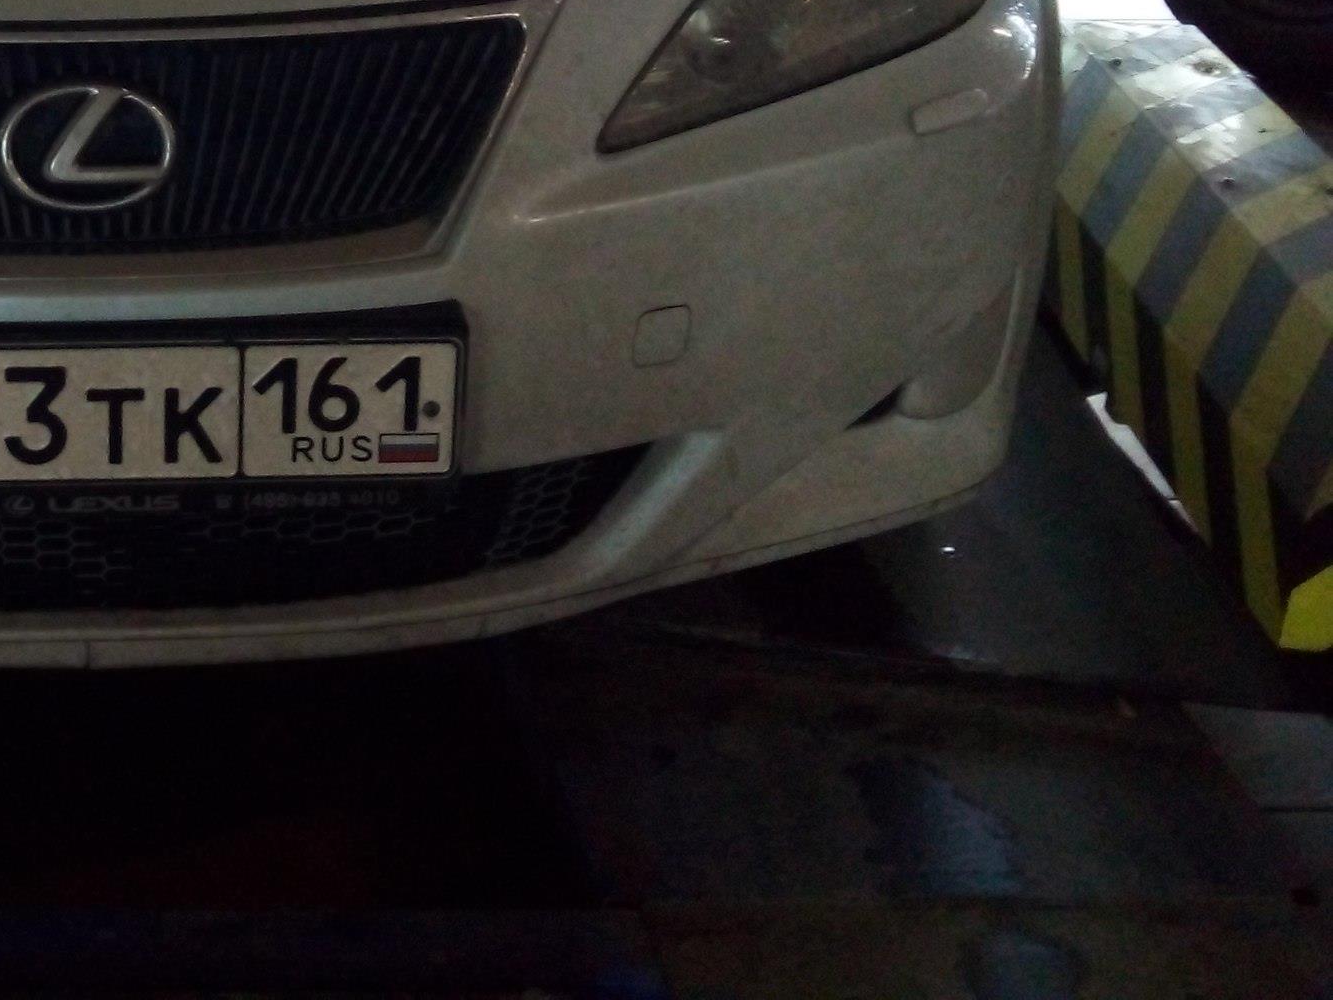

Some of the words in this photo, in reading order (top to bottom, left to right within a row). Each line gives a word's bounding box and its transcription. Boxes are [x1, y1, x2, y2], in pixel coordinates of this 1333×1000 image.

[251, 355, 423, 435] 161
[290, 433, 374, 464] RUS
[47, 494, 180, 514] LEXUS
